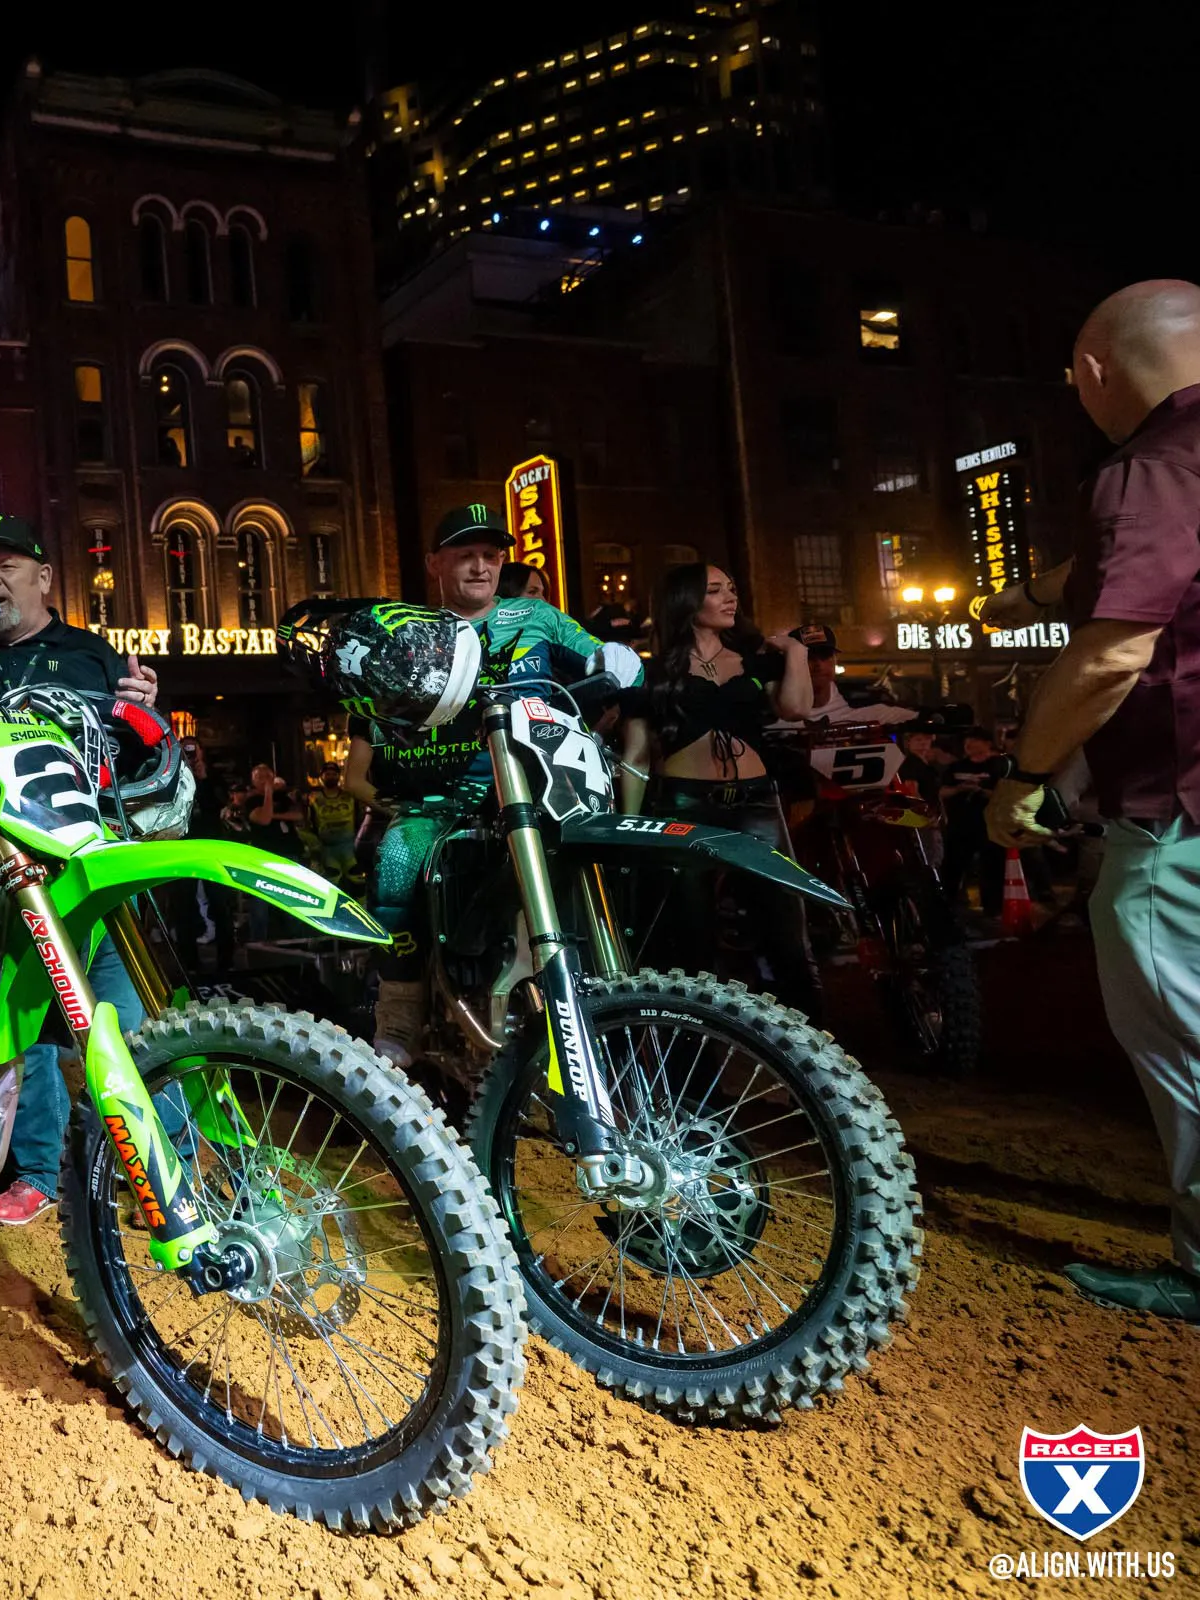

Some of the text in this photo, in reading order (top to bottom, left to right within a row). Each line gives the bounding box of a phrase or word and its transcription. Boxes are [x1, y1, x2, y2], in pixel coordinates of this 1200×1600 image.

[511, 464, 551, 494] LUCKY
[974, 471, 1007, 594] WHISKEY
[181, 623, 278, 656] BASTAR
[407, 665, 421, 688] FOX
[10, 730, 65, 743] SHOWTIME
[398, 741, 483, 760] MONSTER
[552, 730, 608, 796] 4
[831, 746, 886, 787] 5
[615, 819, 667, 834] 5.11
[255, 879, 320, 906] Kawasaki
[37, 942, 91, 1031] SHOWA
[555, 999, 589, 1102] DUNLOP
[103, 1114, 167, 1229] MAXXIS
